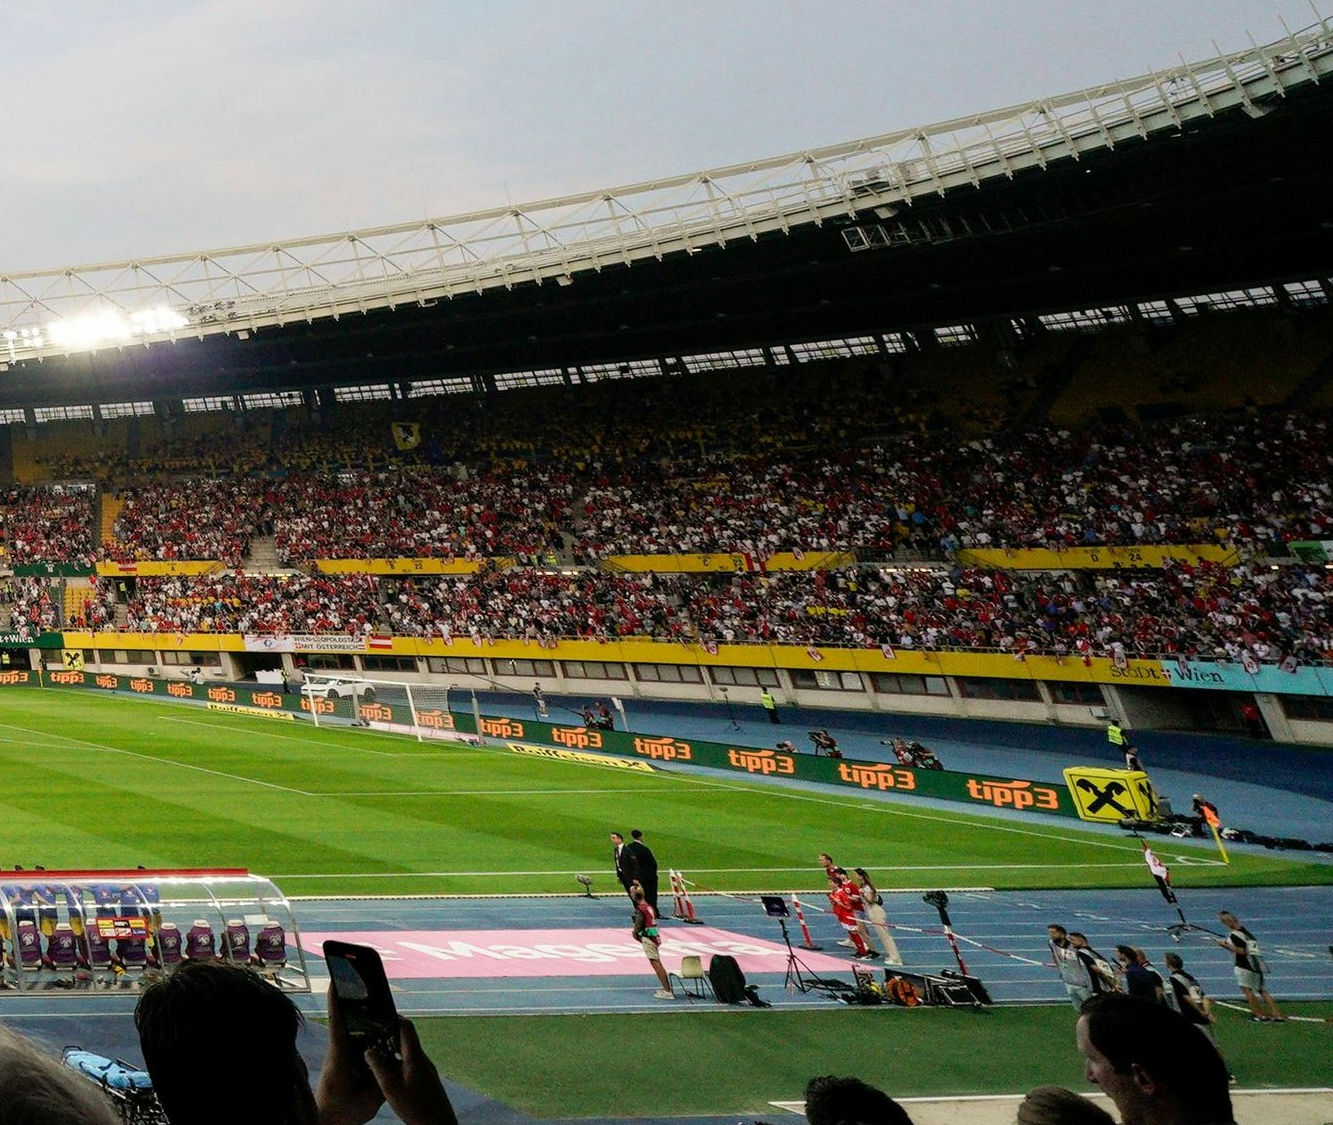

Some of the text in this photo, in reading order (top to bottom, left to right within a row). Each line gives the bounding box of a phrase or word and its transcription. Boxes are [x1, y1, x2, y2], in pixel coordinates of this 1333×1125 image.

[8, 635, 35, 644] Wien
[50, 671, 85, 685] tipp3
[95, 674, 118, 689] tipp3
[1174, 667, 1224, 683] Wien
[129, 679, 154, 693] tipp3
[167, 682, 193, 698] tipp3
[207, 687, 235, 703] tipp3
[251, 692, 283, 709] tipp3
[479, 717, 524, 739] tipp3
[551, 727, 603, 750] tipp3
[634, 737, 692, 762] tipp3
[728, 749, 795, 776] tipp3
[838, 762, 916, 792] tipp3
[966, 778, 1060, 813] tipp3
